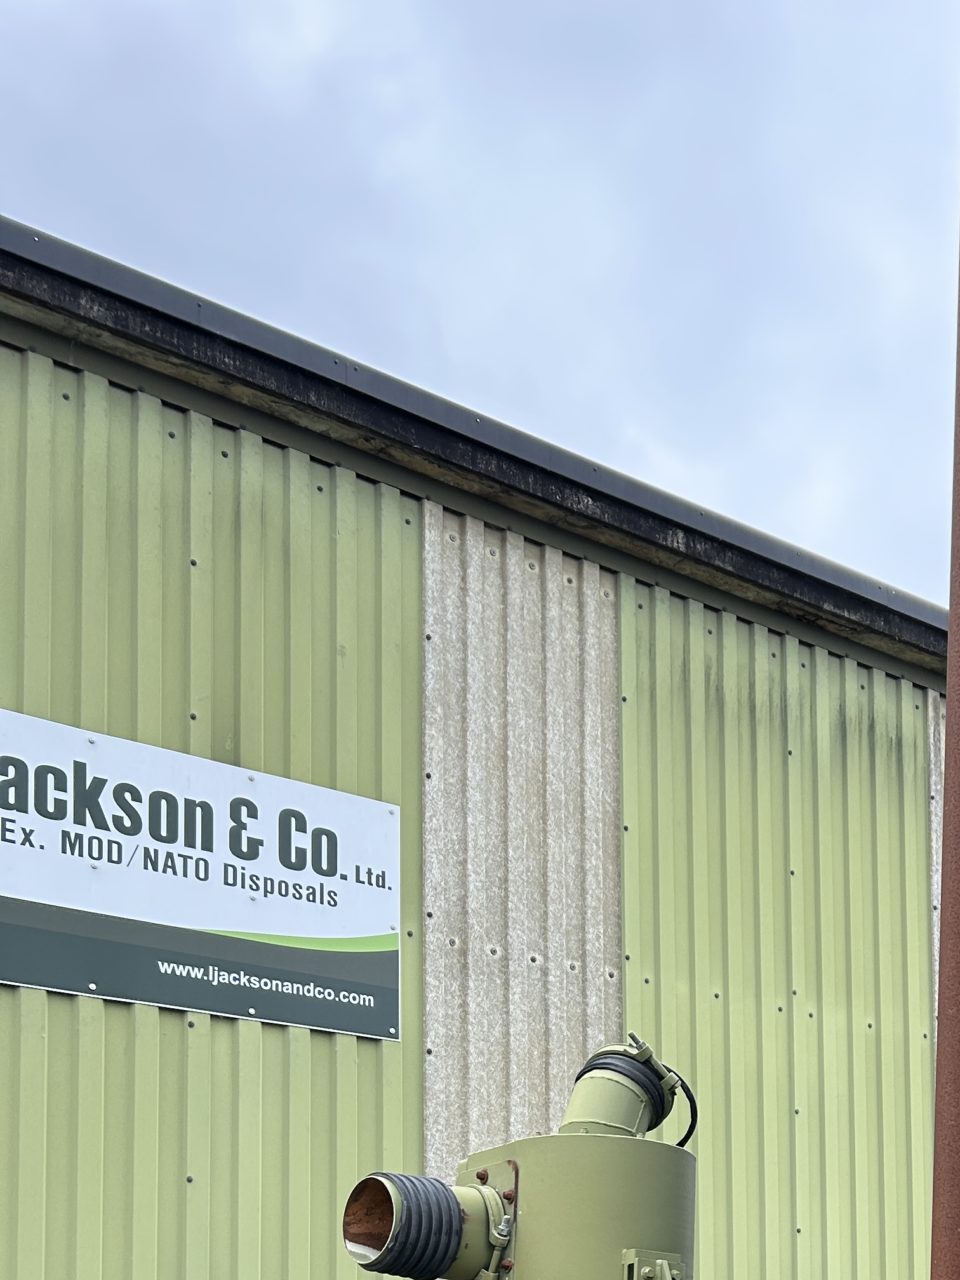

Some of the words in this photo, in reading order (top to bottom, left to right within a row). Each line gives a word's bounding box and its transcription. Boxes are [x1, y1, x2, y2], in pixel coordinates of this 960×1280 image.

[0, 816, 45, 850] Ex.
[61, 829, 209, 882] MOD/NATO
[223, 862, 338, 907] Disposals
[228, 797, 264, 861] &
[278, 808, 347, 880] Co.
[355, 864, 392, 891] Ltd.
[157, 960, 375, 1008] www.ljacksonandco.com
